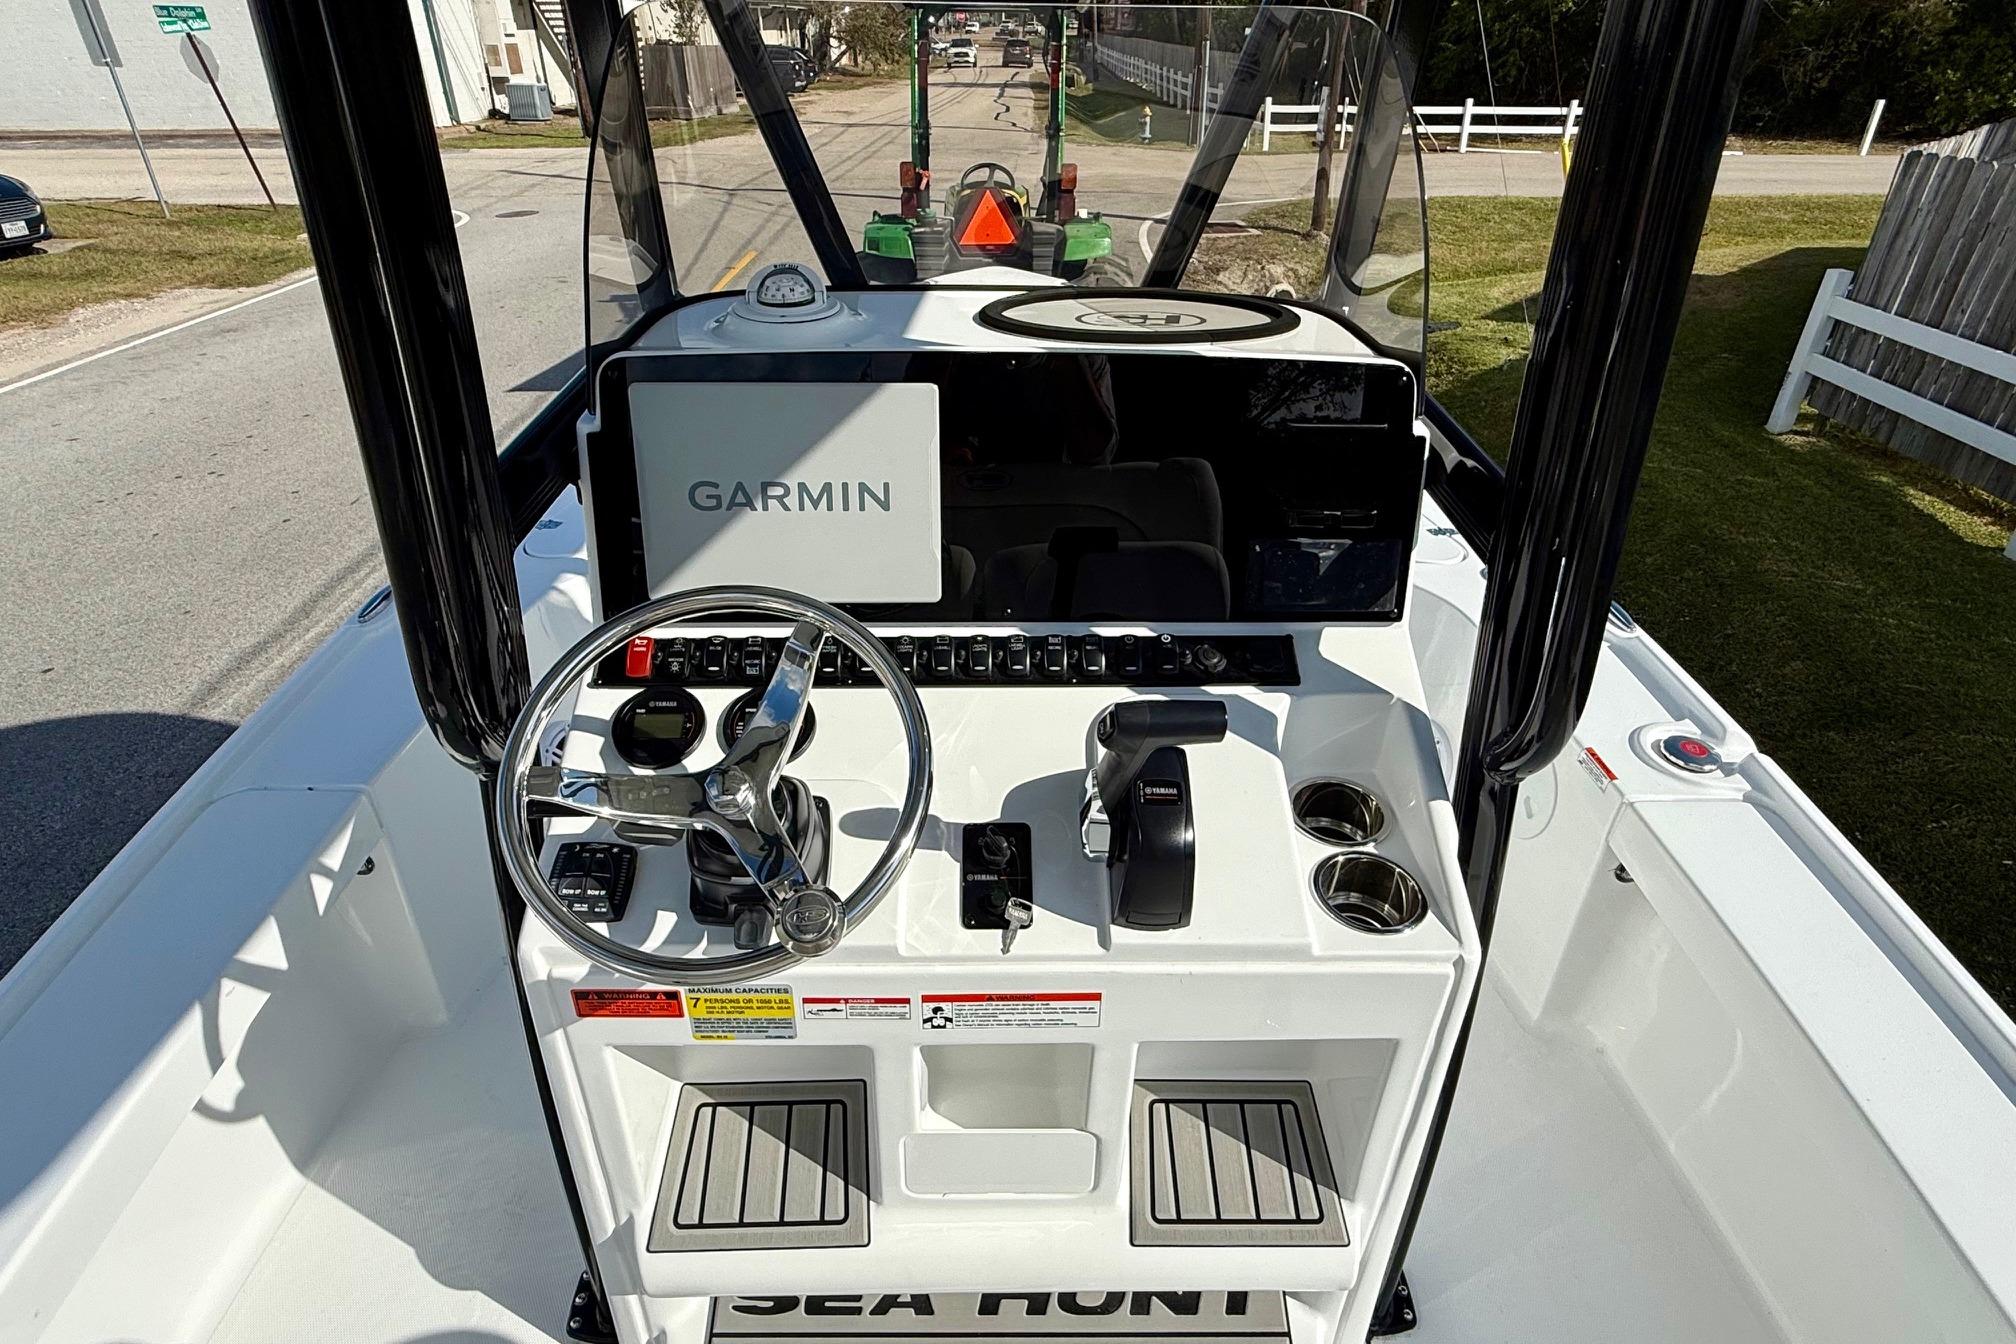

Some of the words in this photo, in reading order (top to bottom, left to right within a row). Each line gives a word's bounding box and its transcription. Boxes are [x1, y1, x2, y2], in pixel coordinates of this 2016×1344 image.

[154, 7, 169, 16] Blue
[169, 7, 197, 18] Dolphin
[688, 480, 890, 512] GARMIN
[689, 997, 701, 1008] 7
